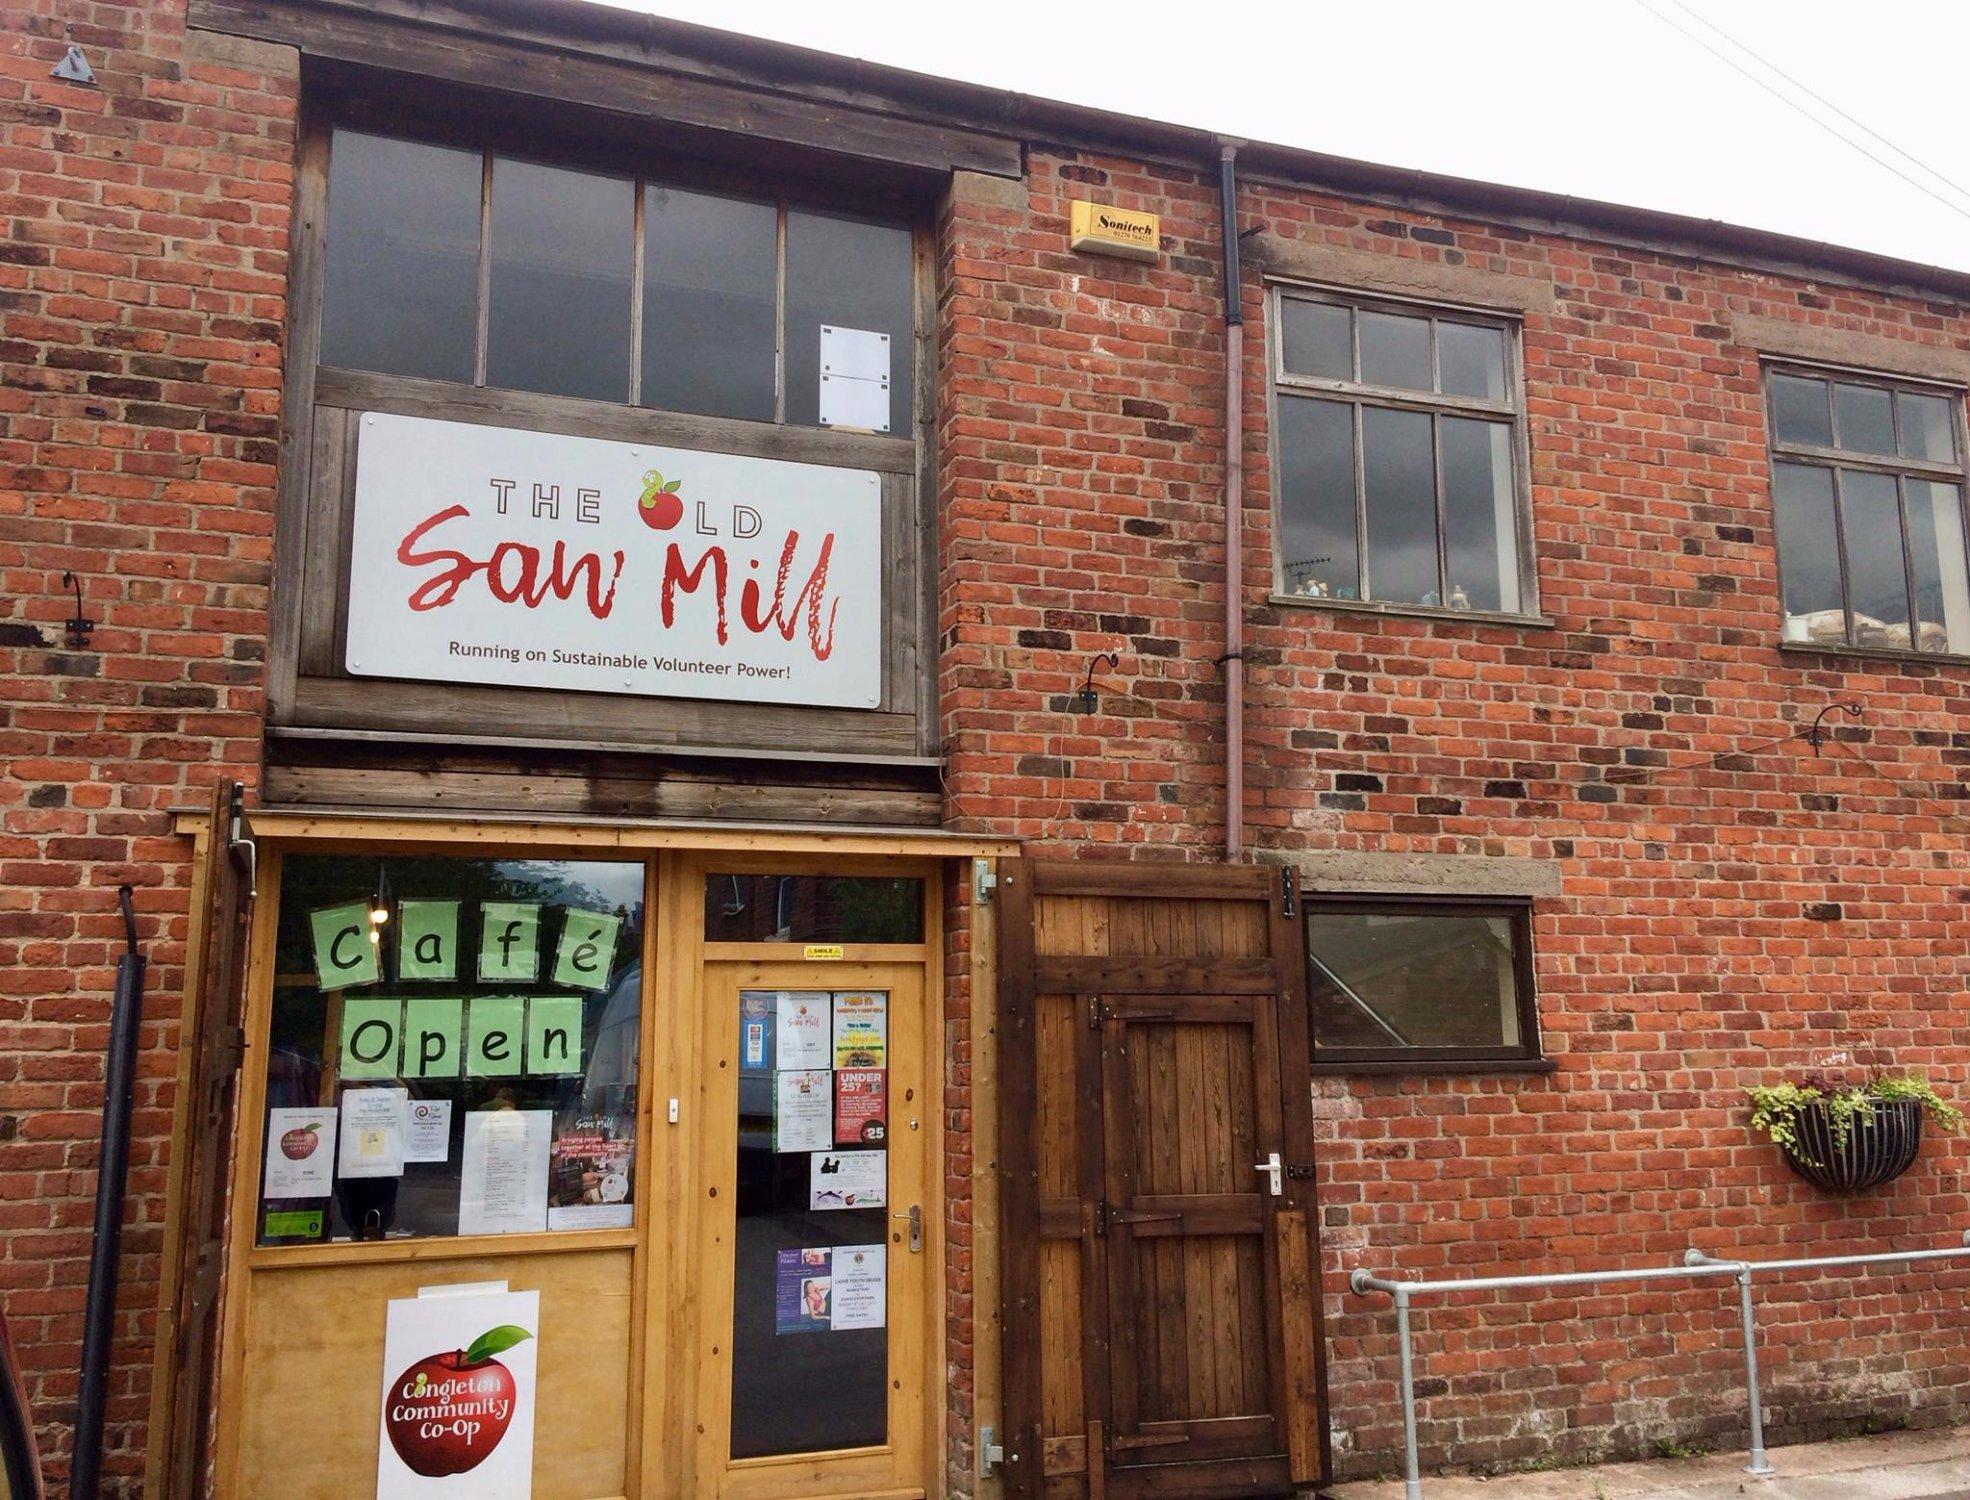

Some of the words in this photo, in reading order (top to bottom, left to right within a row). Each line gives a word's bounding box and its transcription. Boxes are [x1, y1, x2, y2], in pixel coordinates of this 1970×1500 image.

[1098, 215, 1152, 235] Sonitech
[490, 479, 601, 524] THE
[397, 504, 625, 620] Saw
[662, 530, 840, 661] Mill
[448, 641, 520, 663] Running
[525, 648, 547, 663] on
[552, 648, 648, 670] Sustainable
[653, 655, 732, 675] Volunteer
[737, 662, 792, 681] Power!
[330, 920, 603, 973] Café
[349, 1019, 568, 1077] Open
[841, 1073, 882, 1082] UNDER
[841, 1083, 861, 1092] 25?
[867, 1128, 885, 1139] 25
[402, 1377, 502, 1404] Congleton
[392, 1398, 510, 1422] Community
[420, 1420, 481, 1446] Co-Op
